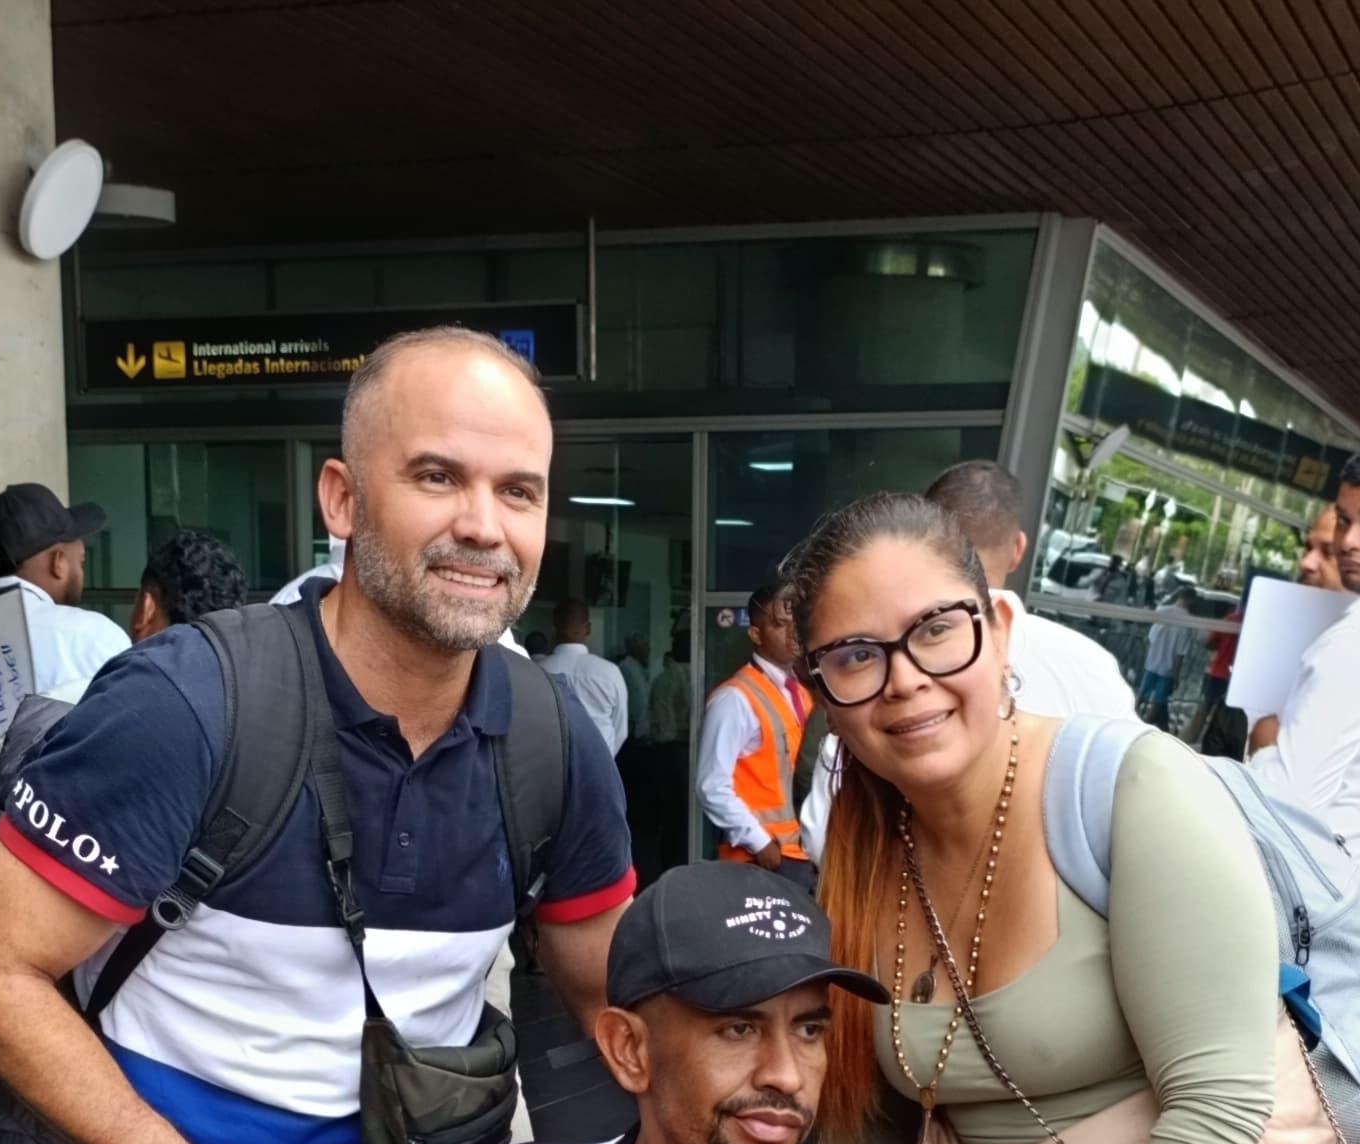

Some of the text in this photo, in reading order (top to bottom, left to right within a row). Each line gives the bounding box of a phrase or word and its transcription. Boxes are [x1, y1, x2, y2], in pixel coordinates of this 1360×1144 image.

[192, 339, 330, 357] International arrivals
[192, 359, 261, 379] Llegadas
[15, 782, 101, 863] POLO
